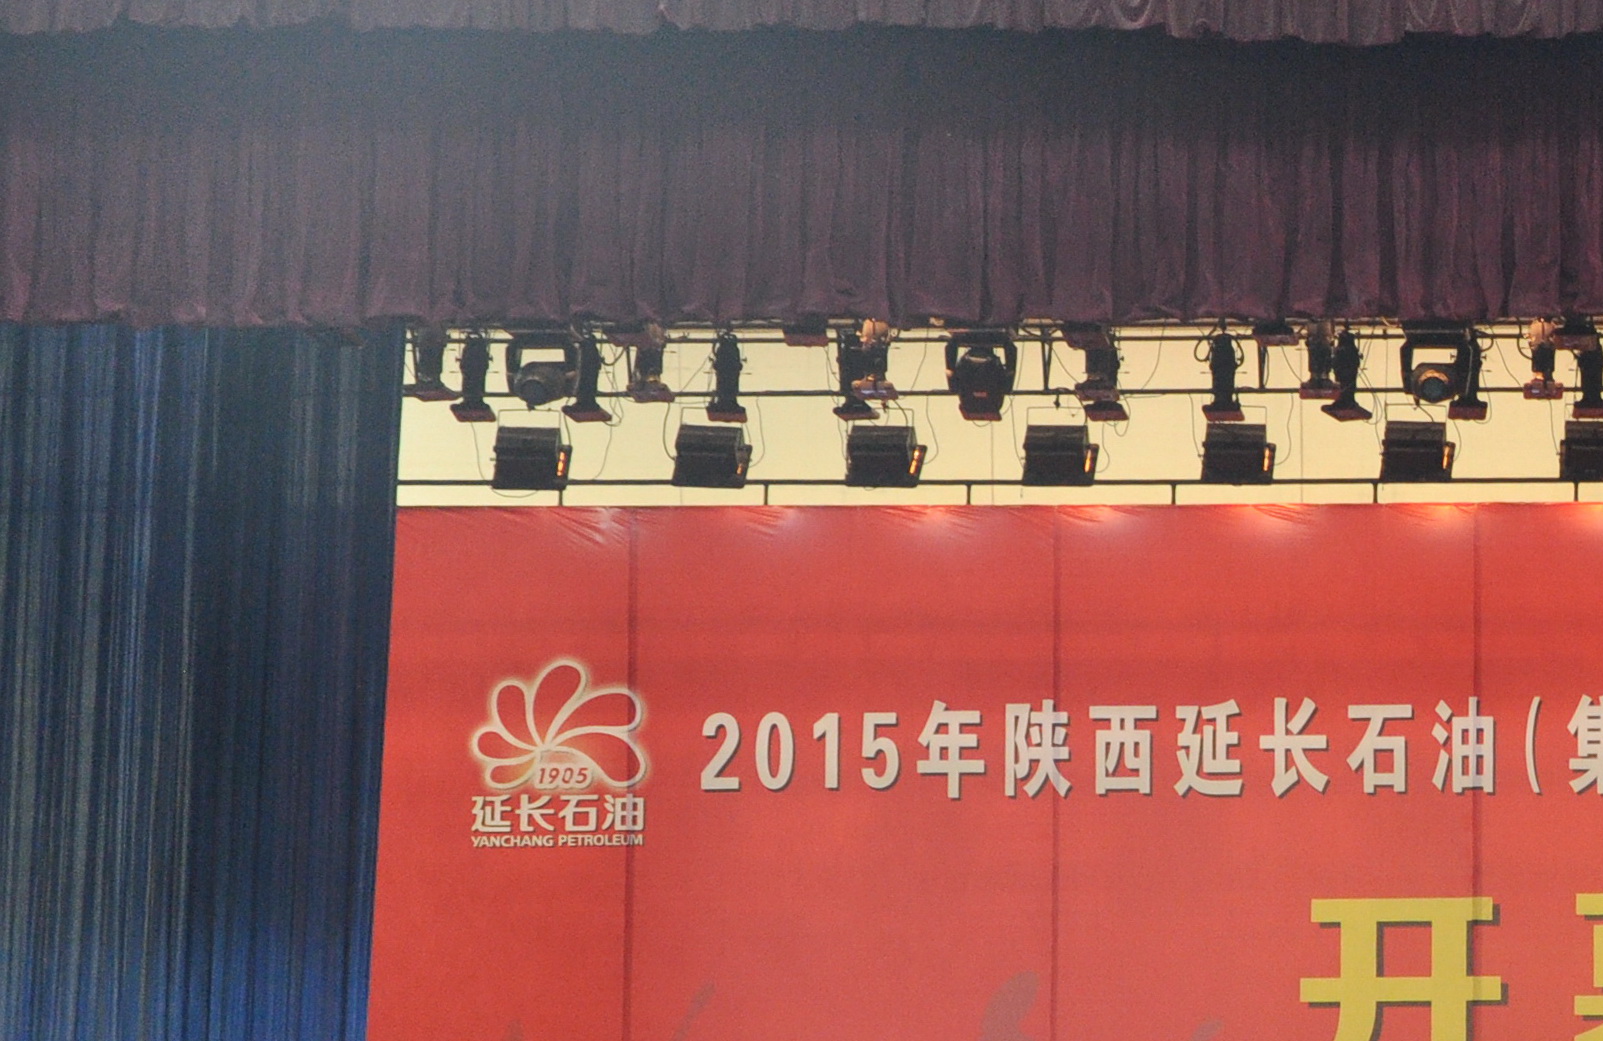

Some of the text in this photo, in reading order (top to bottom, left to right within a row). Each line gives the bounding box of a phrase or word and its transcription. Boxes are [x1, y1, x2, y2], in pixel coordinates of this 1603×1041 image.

[537, 767, 589, 784] 1905
[470, 794, 645, 832] 延长石油
[471, 833, 643, 847] YANCHANG PETROLEUM
